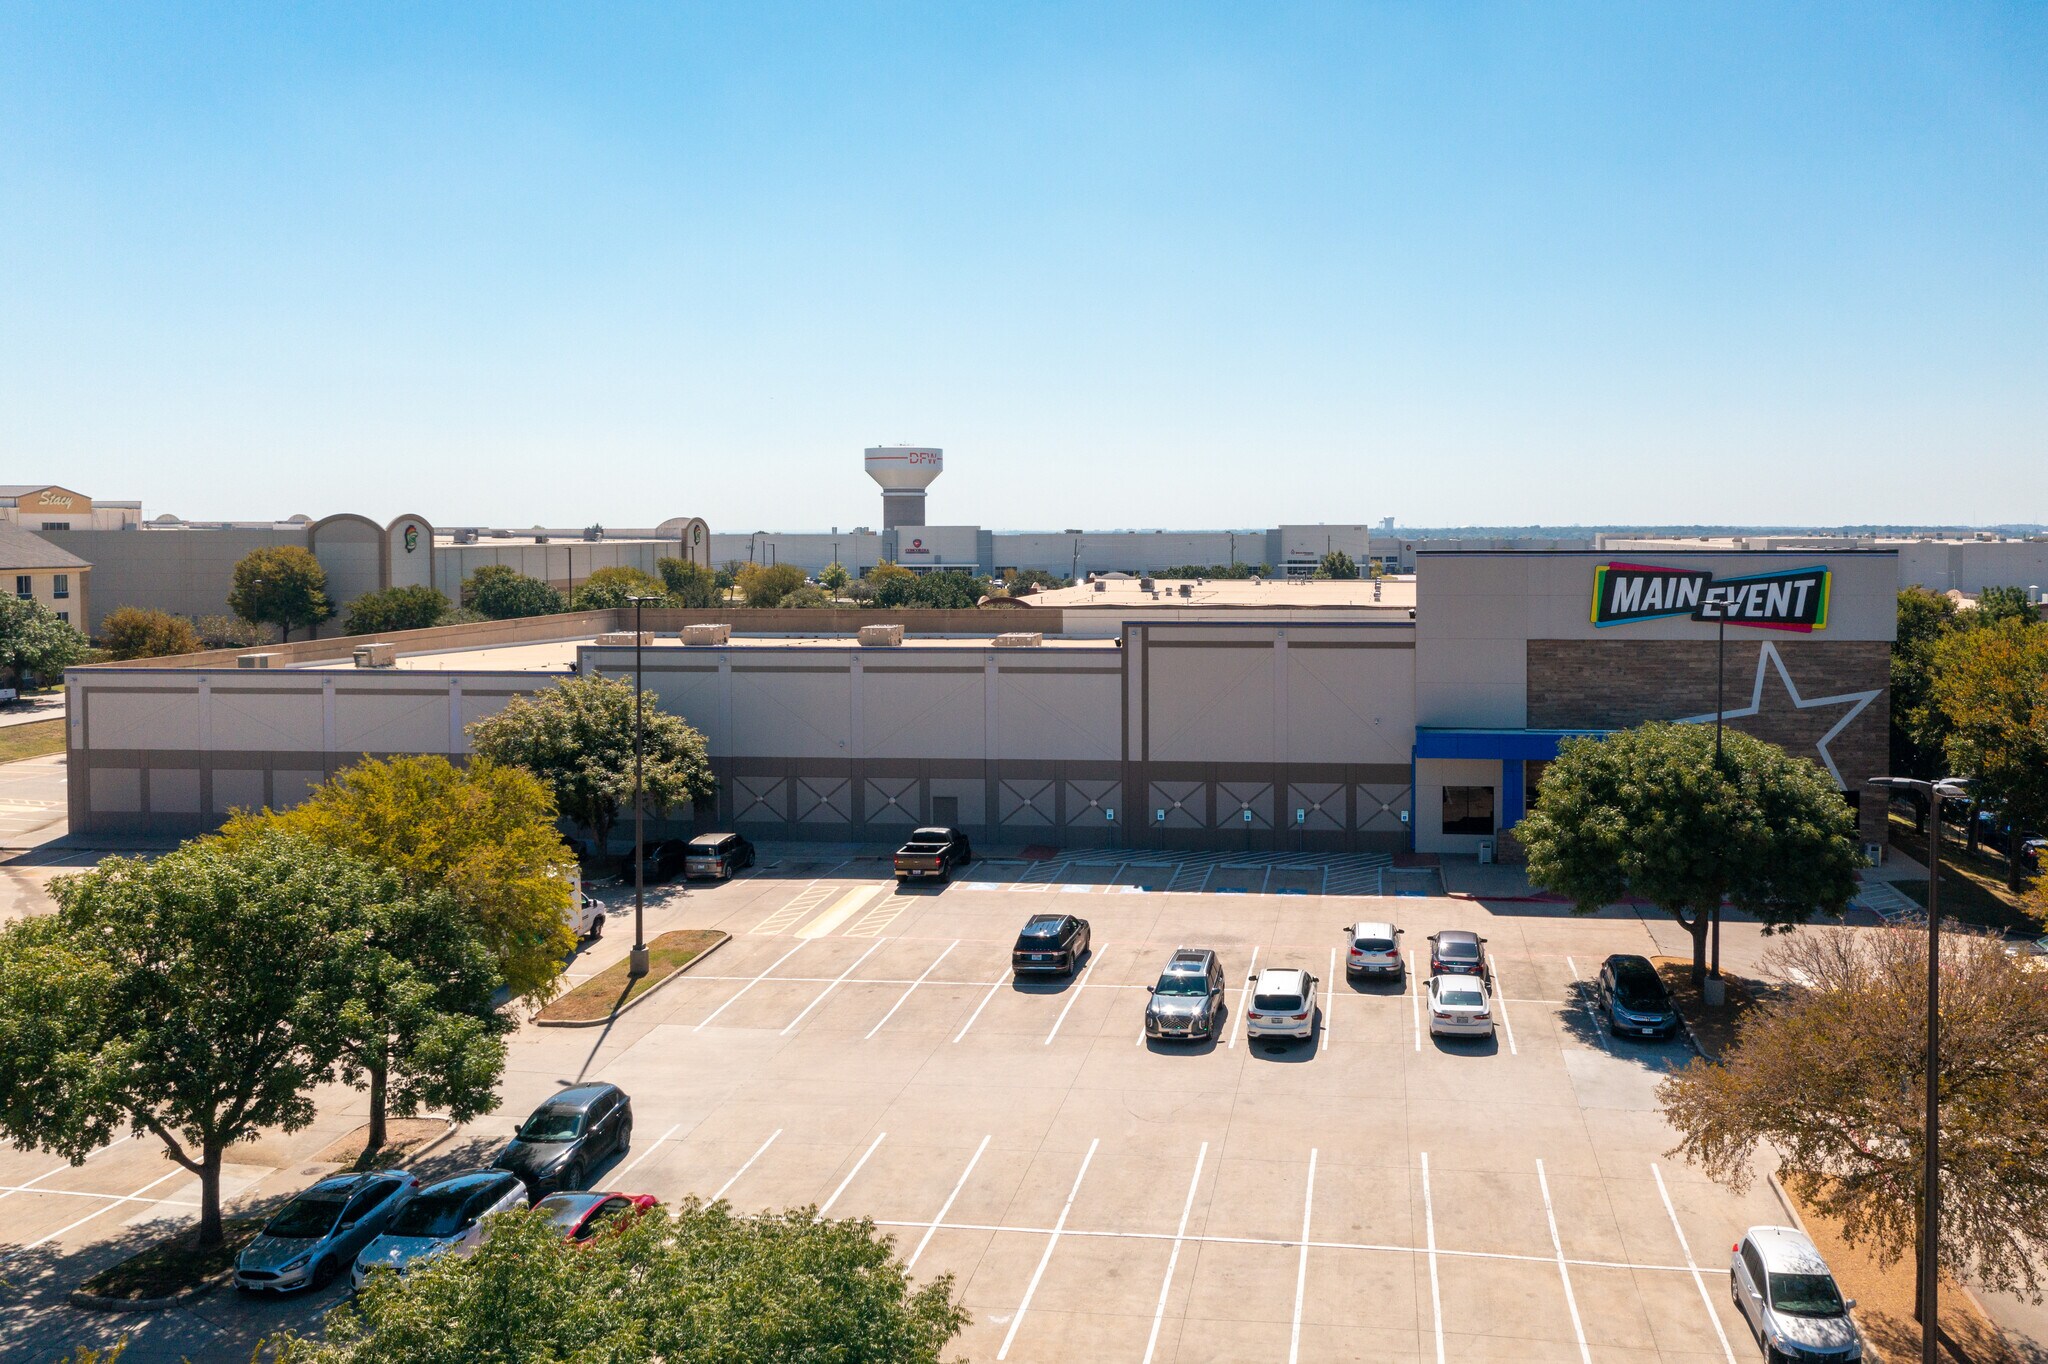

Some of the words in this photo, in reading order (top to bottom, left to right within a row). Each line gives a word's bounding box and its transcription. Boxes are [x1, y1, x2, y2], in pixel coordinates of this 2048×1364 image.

[909, 452, 937, 464] DFW
[39, 491, 74, 509] Stacy
[1611, 577, 1703, 614] MAIN
[1702, 579, 1816, 617] EVENT
